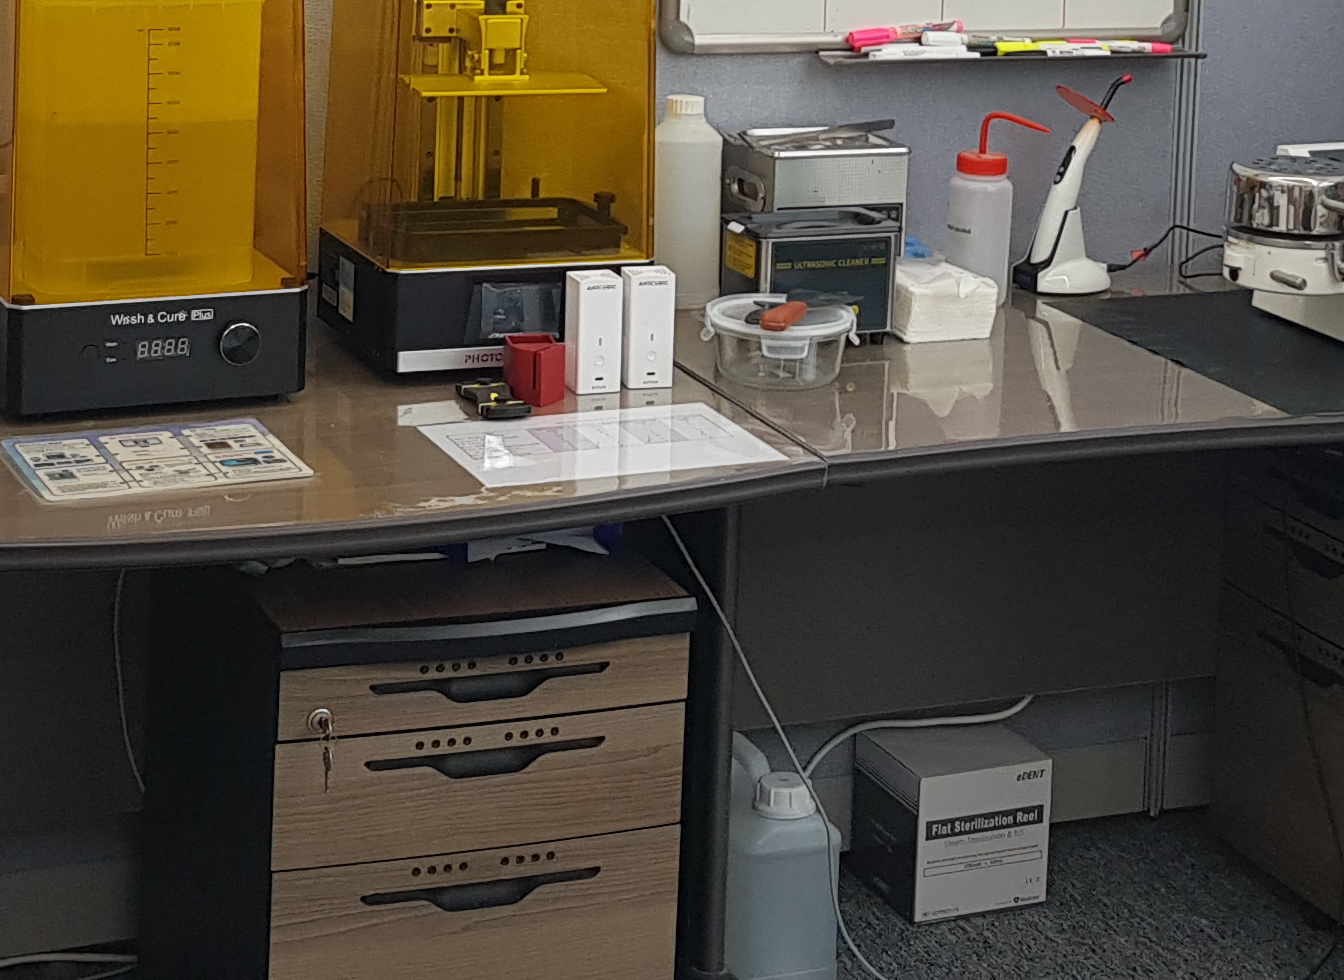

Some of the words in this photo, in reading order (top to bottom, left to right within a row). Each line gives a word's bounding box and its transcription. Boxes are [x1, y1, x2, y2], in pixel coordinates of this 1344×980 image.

[793, 259, 837, 270] ULTRASONIC
[838, 258, 869, 268] CLEANER
[111, 313, 145, 326] Wash
[147, 313, 155, 324] &
[157, 311, 187, 323] Cure
[192, 309, 213, 320] Plus
[464, 352, 503, 364] PHOTO
[1016, 769, 1046, 782] eDENT
[931, 823, 952, 837] Flat
[954, 814, 1014, 833] Sterilization
[1016, 808, 1038, 823] Reel
